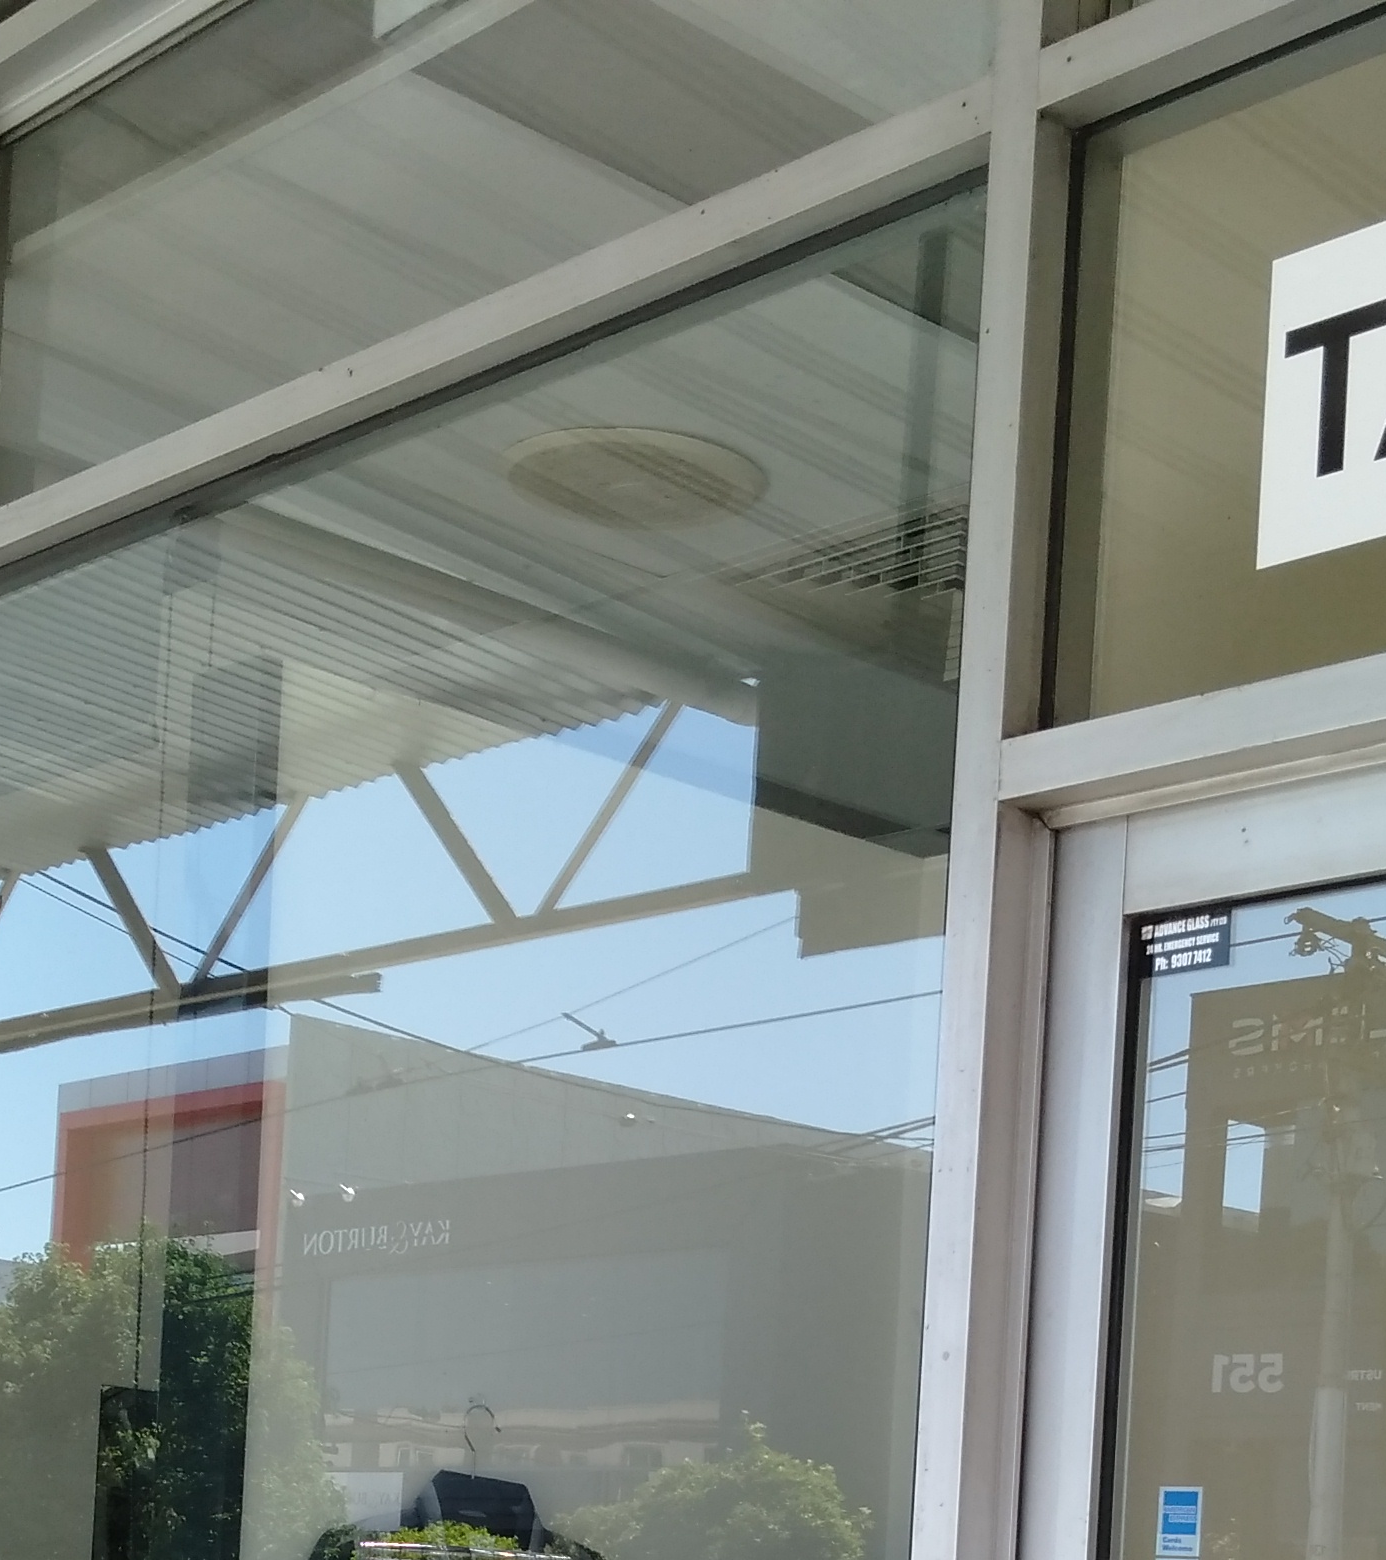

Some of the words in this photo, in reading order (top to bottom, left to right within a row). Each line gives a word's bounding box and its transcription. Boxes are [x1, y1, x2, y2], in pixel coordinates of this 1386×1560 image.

[1154, 918, 1186, 938] ADVANCE
[1186, 914, 1210, 931] GLASS
[1164, 936, 1195, 951] EMERGENCY
[1196, 932, 1220, 946] SERVICE
[1155, 957, 1169, 972] Ph:
[1171, 951, 1193, 969] 9307
[1193, 948, 1212, 965] 7412
